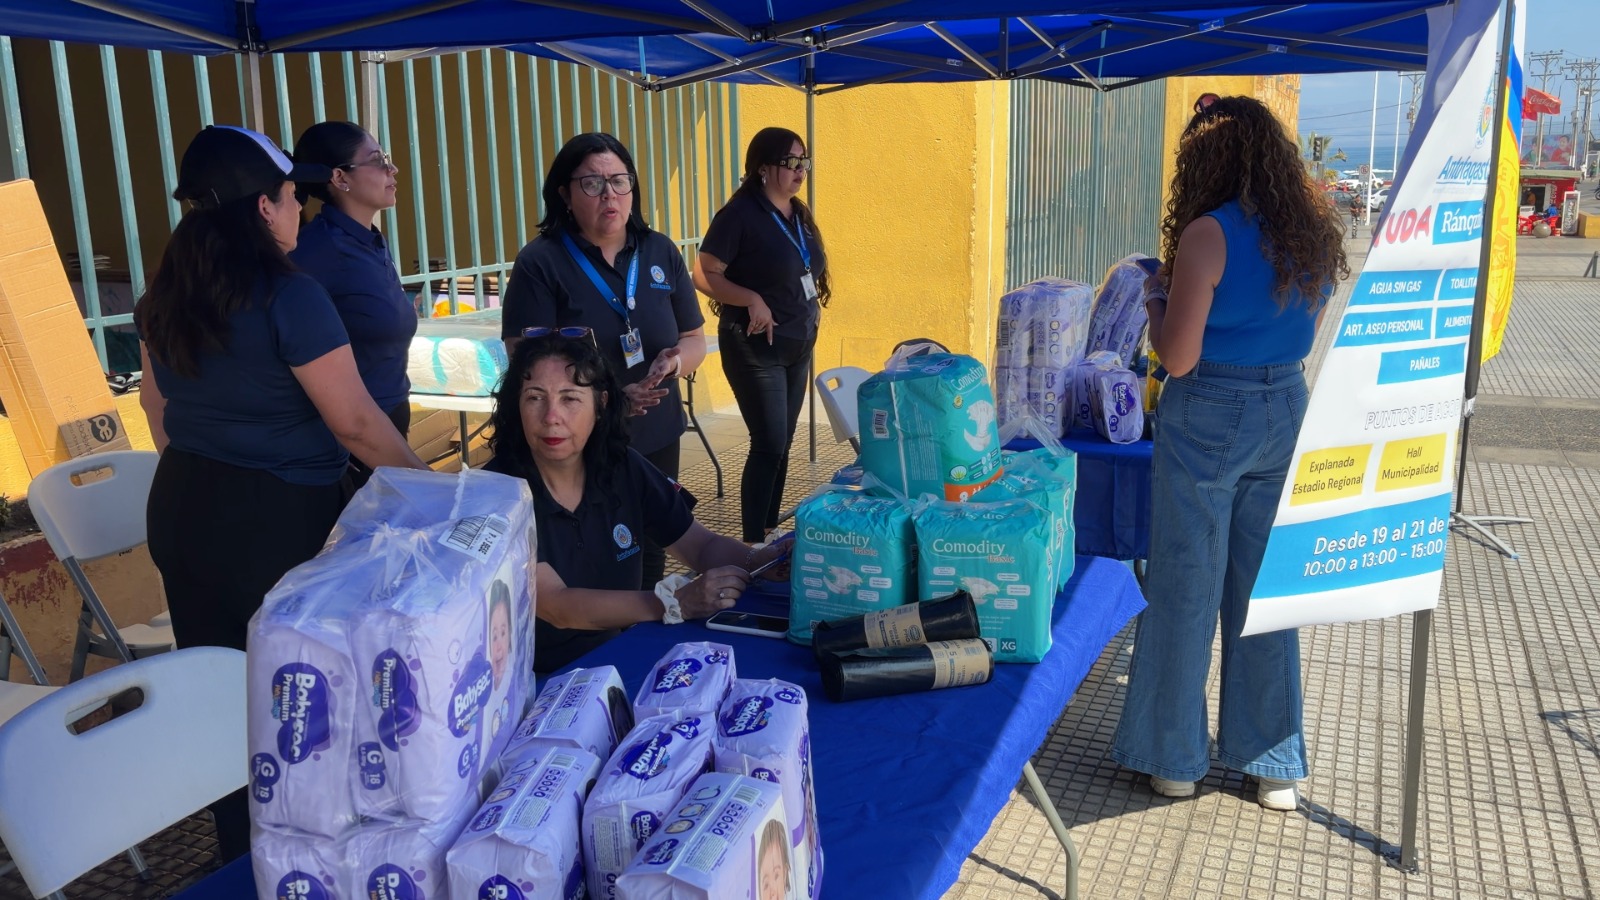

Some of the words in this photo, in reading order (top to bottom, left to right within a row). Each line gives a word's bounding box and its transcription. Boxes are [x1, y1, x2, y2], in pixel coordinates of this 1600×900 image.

[1369, 282, 1393, 294] AGUA
[1393, 281, 1406, 293] SIN
[1406, 280, 1422, 292] GAS
[1344, 324, 1364, 337] ART.
[1365, 322, 1387, 335] ASEO
[1387, 319, 1424, 334] PERSONAL
[1409, 356, 1441, 371] PAÑALES
[1365, 407, 1417, 431] PUNTOS
[1418, 403, 1435, 424] DE
[1406, 446, 1423, 459] Hall
[1309, 456, 1355, 474] Explanada
[1381, 461, 1440, 480] Municipalidad
[1292, 480, 1326, 495] Estadio
[1328, 473, 1364, 491] Regional
[805, 526, 870, 549] Comodity
[1314, 530, 1367, 556] Desde
[1372, 526, 1388, 545] 19
[1392, 522, 1406, 541] al
[1410, 519, 1425, 539] 21
[1428, 516, 1444, 534] de
[933, 538, 1006, 557] Comodity
[1303, 556, 1347, 578] 10:00
[1349, 558, 1358, 571] a
[1361, 547, 1397, 569] 13:00
[1411, 538, 1443, 560] 15:00
[1001, 641, 1017, 651] XG
[382, 658, 394, 709] Premium
[281, 673, 294, 722] Premium
[454, 668, 491, 719] Babysec
[727, 695, 763, 734] Babysec
[367, 750, 383, 765] G
[462, 749, 470, 765] G
[260, 761, 276, 778] G
[369, 773, 382, 785] 18
[259, 786, 271, 799] 18
[640, 813, 651, 843] Baby
